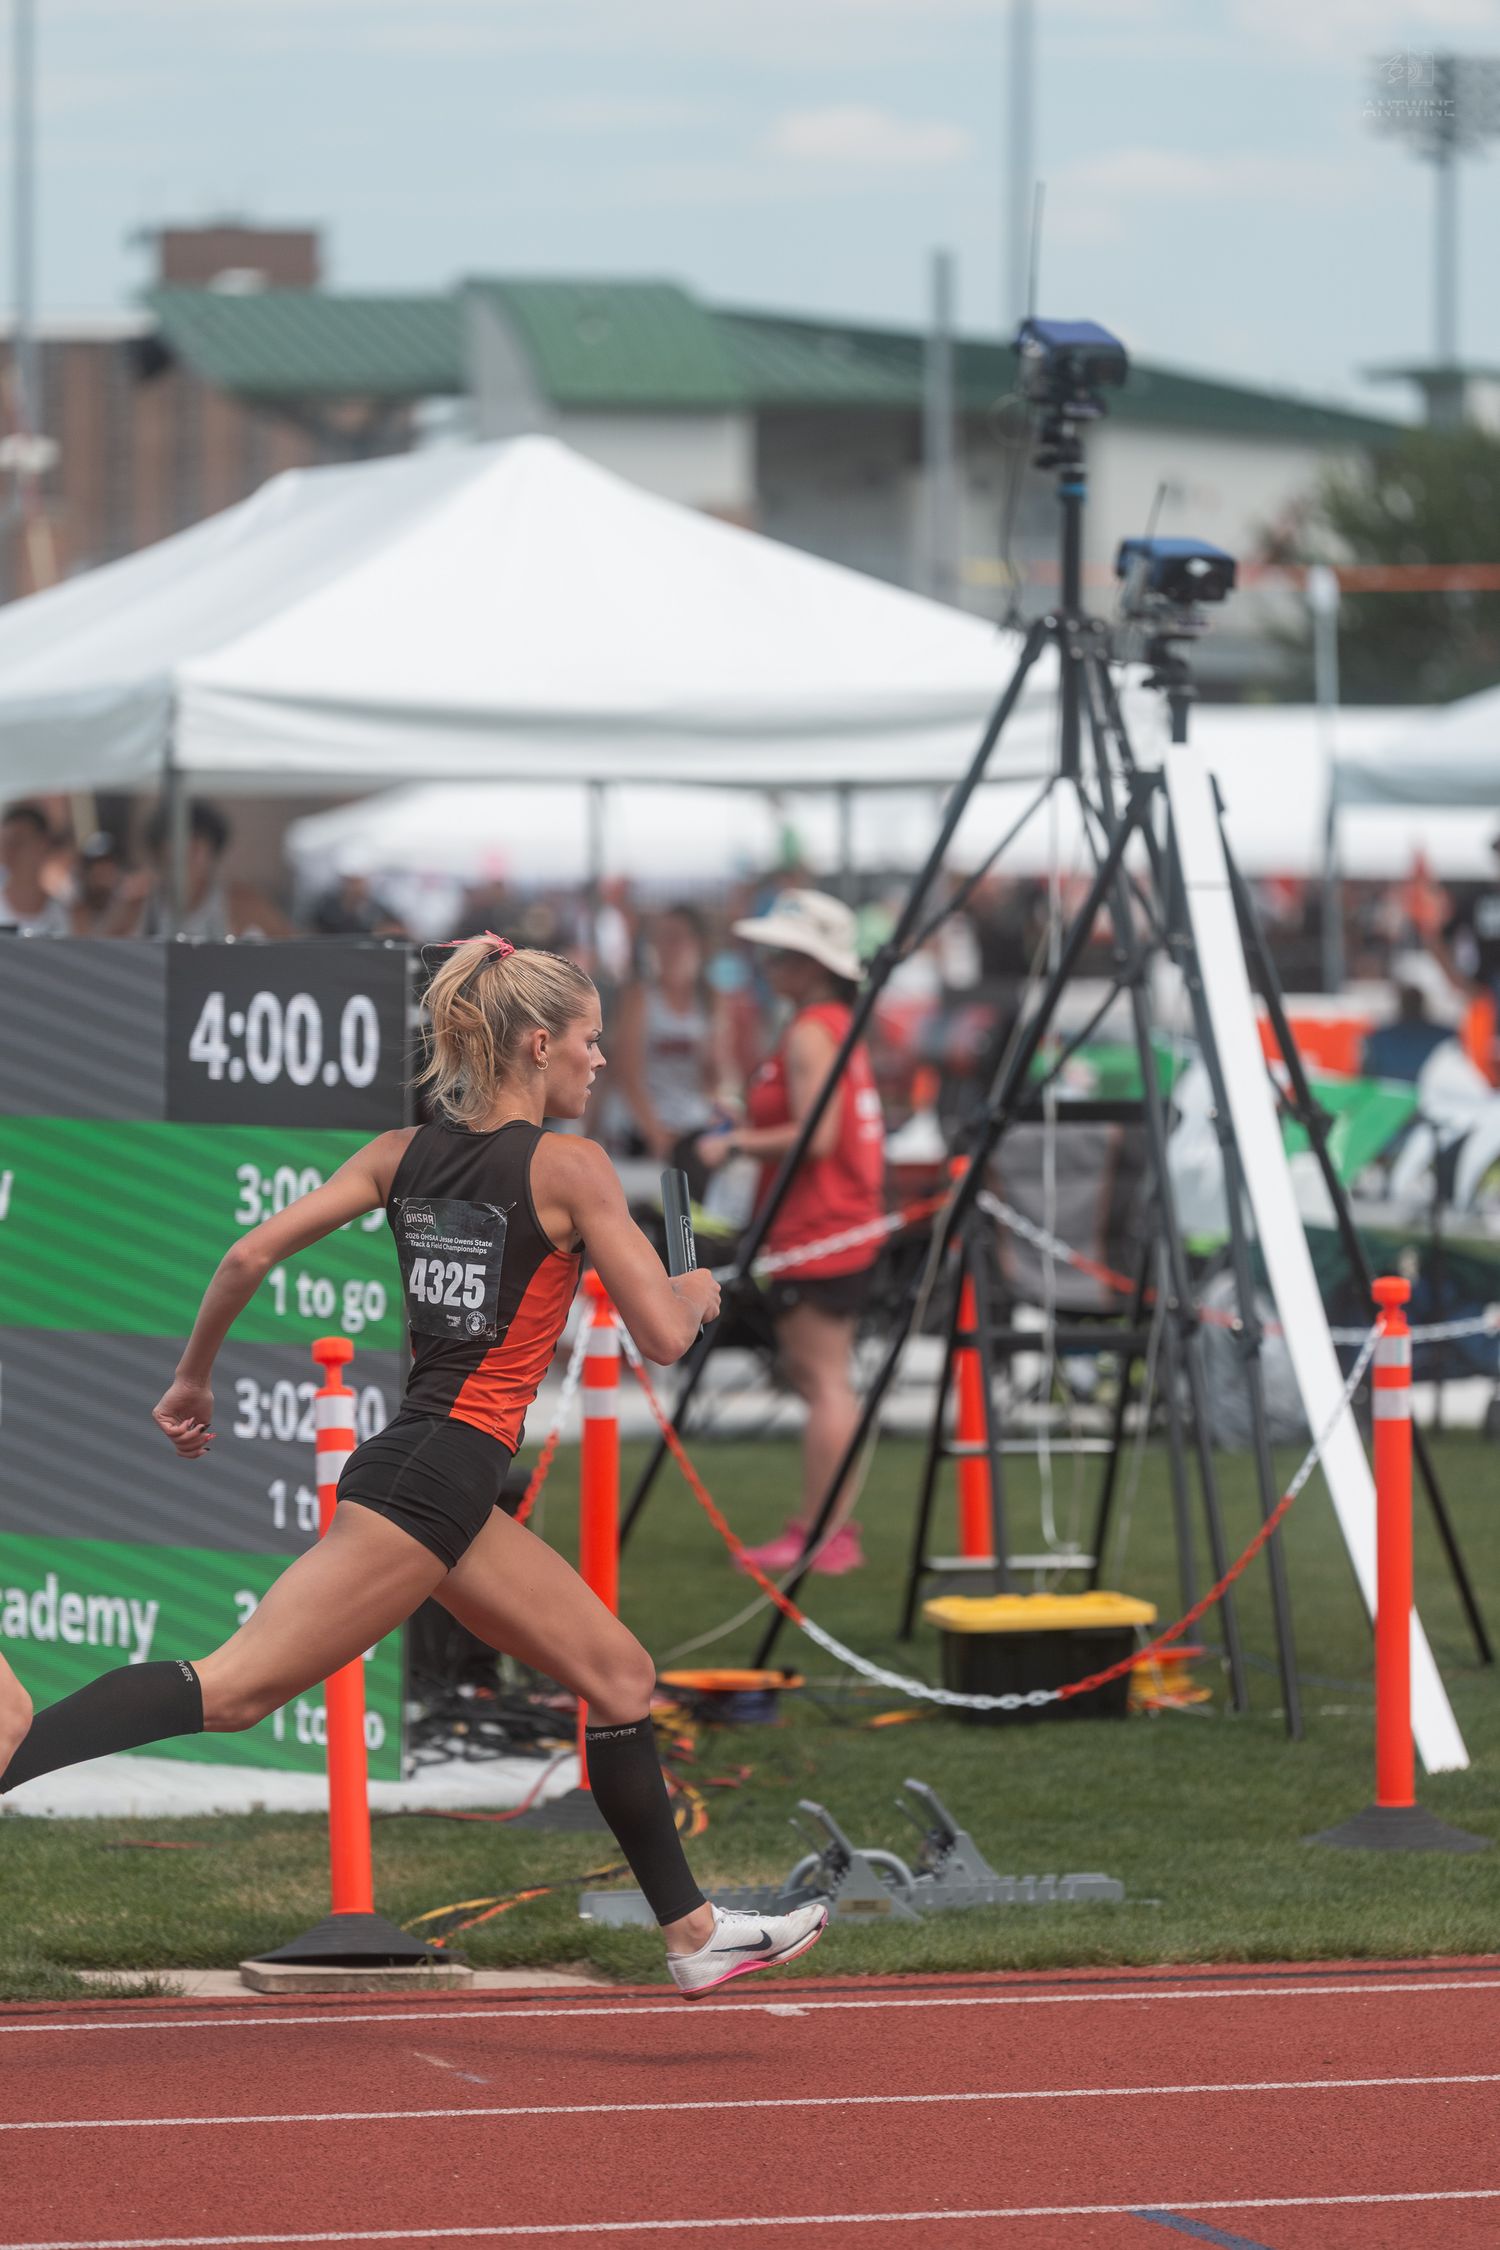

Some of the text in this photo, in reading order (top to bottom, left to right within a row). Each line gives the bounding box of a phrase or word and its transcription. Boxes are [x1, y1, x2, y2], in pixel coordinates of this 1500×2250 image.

[189, 990, 380, 1088] 4:00.0
[406, 1213, 434, 1225] OHSAA
[420, 1233, 438, 1242] OHSAA
[439, 1235, 453, 1244] Jesse
[454, 1237, 473, 1246] Owens
[474, 1239, 493, 1248] State
[410, 1239, 487, 1255] Track & Field Championships
[268, 1266, 387, 1334] 1 to go
[409, 1258, 486, 1309] 4325
[268, 1478, 287, 1530] 1
[0, 1572, 160, 1665] ademy
